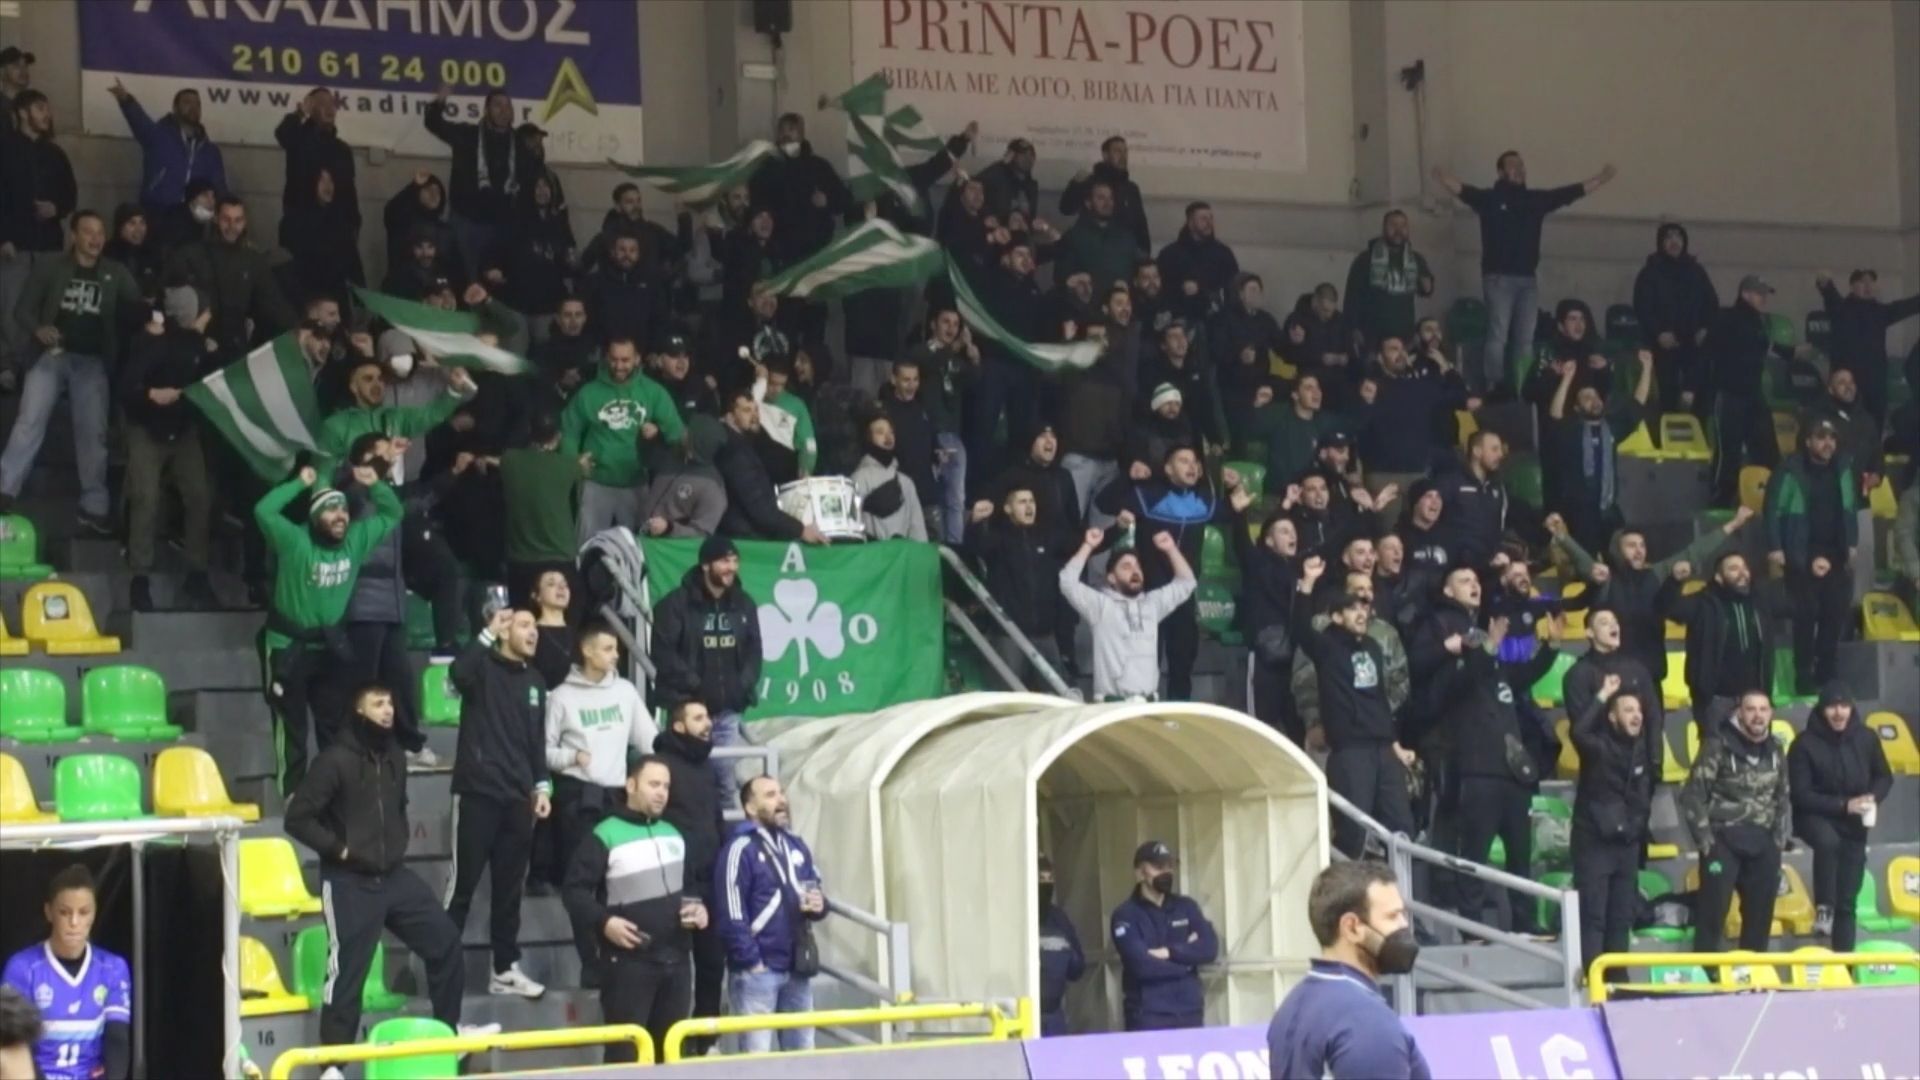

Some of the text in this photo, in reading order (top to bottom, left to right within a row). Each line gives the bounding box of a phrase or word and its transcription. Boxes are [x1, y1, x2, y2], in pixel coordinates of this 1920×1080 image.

[133, 0, 590, 45] ΔΗΜΟΣ
[232, 44, 507, 87] 210 61 24 000
[965, 71, 1000, 95] ΜΕ
[1083, 79, 1156, 105] ΒΙΒΛΙΑ
[1163, 84, 1198, 107] ΓΙΑ
[1205, 87, 1280, 112] ΠΑΝΤΑ
[759, 671, 855, 705] 1908
[56, 1043, 81, 1068] 11
[257, 1030, 275, 1047] 16
